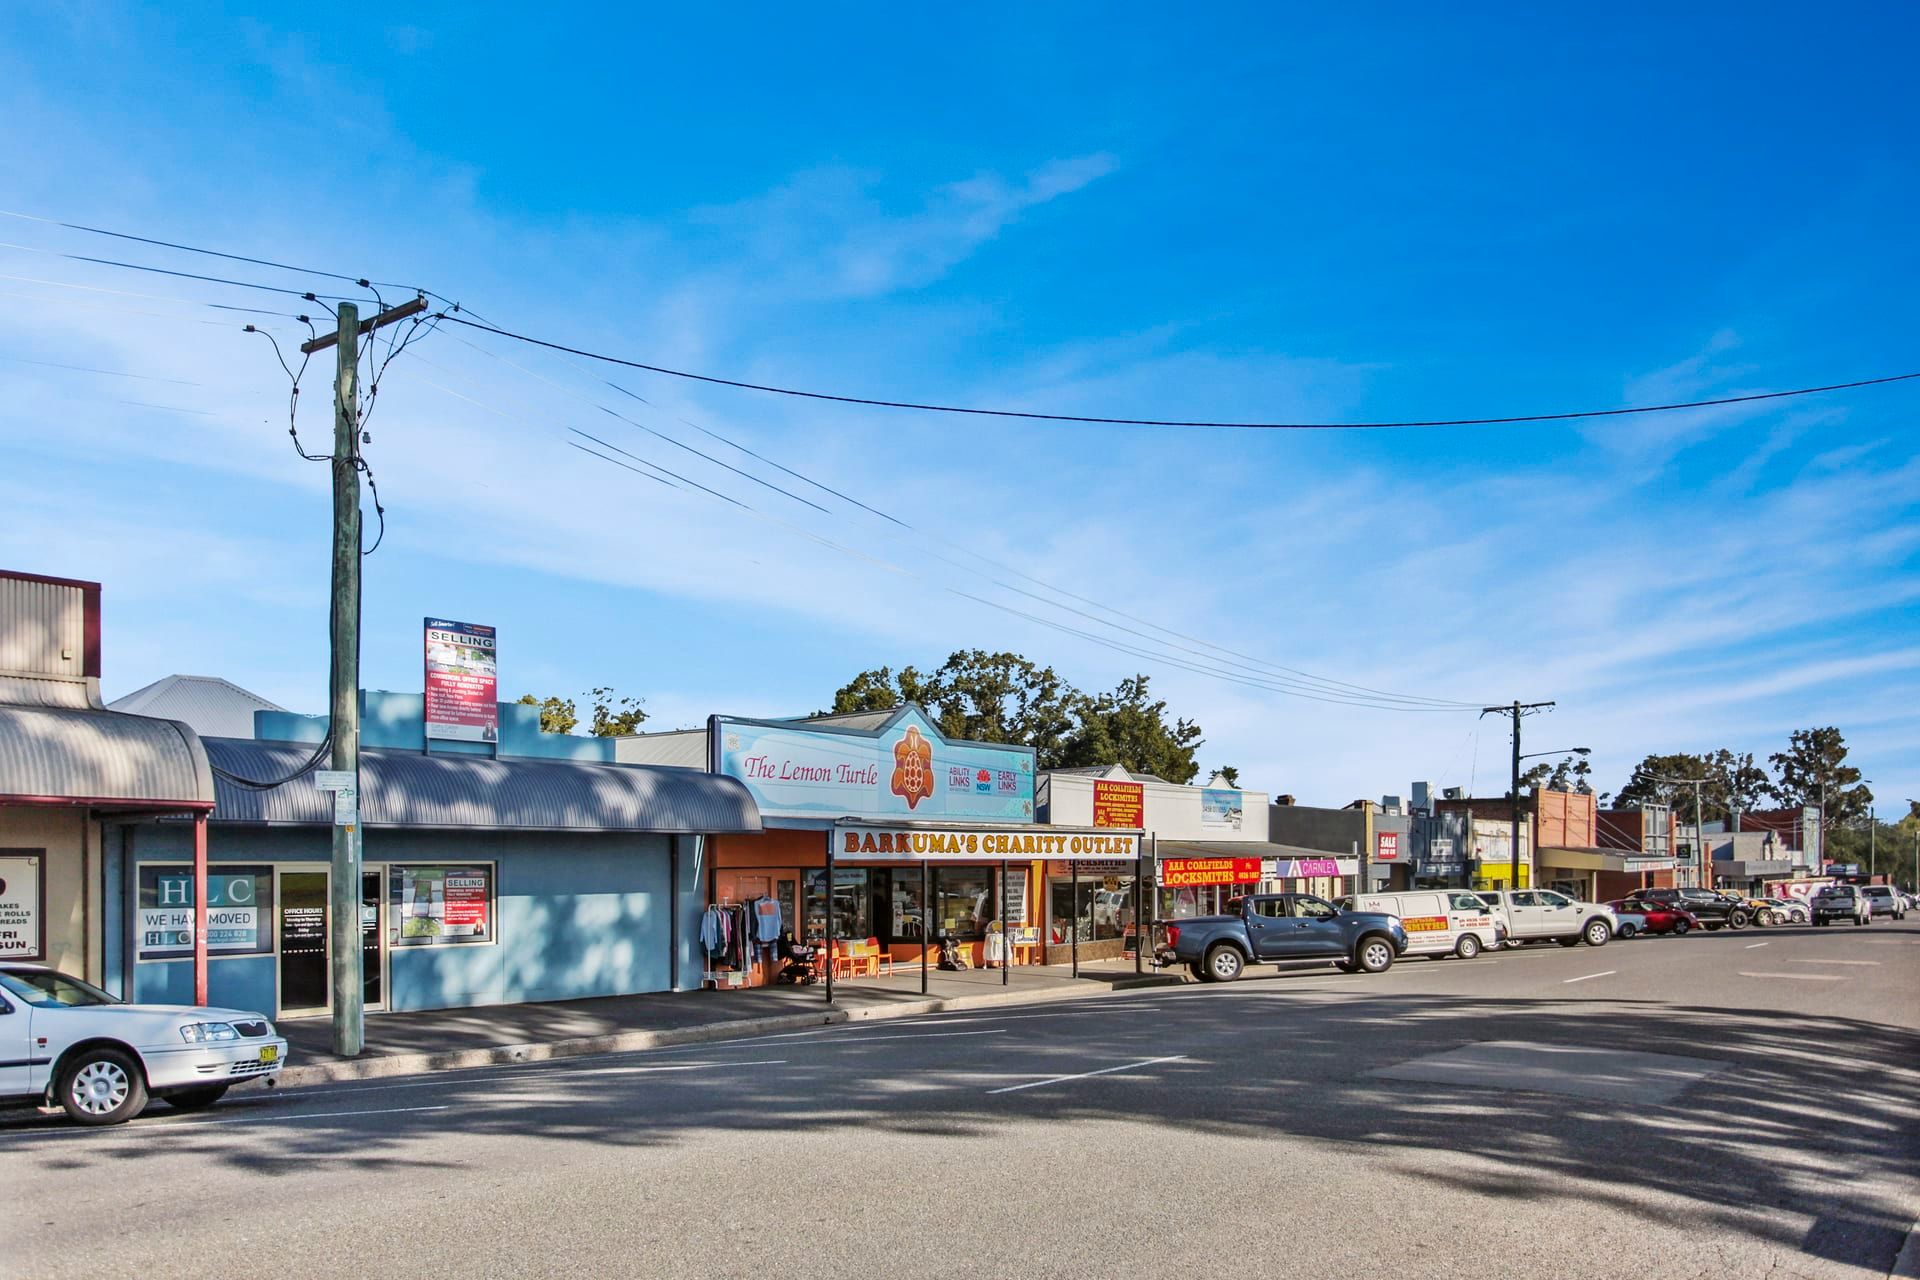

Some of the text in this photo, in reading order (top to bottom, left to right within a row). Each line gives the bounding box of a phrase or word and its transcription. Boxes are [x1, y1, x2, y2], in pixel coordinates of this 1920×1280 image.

[431, 631, 493, 648] SELLING
[745, 756, 878, 785] The Lemon Turtle
[949, 767, 970, 776] ABILITY
[998, 771, 1016, 781] EARLY
[949, 776, 970, 787] LINKS
[998, 782, 1016, 791] LINKS
[977, 784, 991, 792] NSW
[338, 789, 354, 798] 2P
[1100, 793, 1138, 802] LOCKSMITHS
[844, 832, 1133, 854] BARKUMA'S CHARITY OUTLET
[1381, 836, 1396, 848] SALE
[1168, 861, 1184, 871] AAA
[1187, 861, 1233, 870] COALFIELDS
[447, 879, 483, 887] SELLING
[1165, 872, 1234, 884] LOCKSMITHS
[146, 913, 251, 926] WE HAV MOVED
